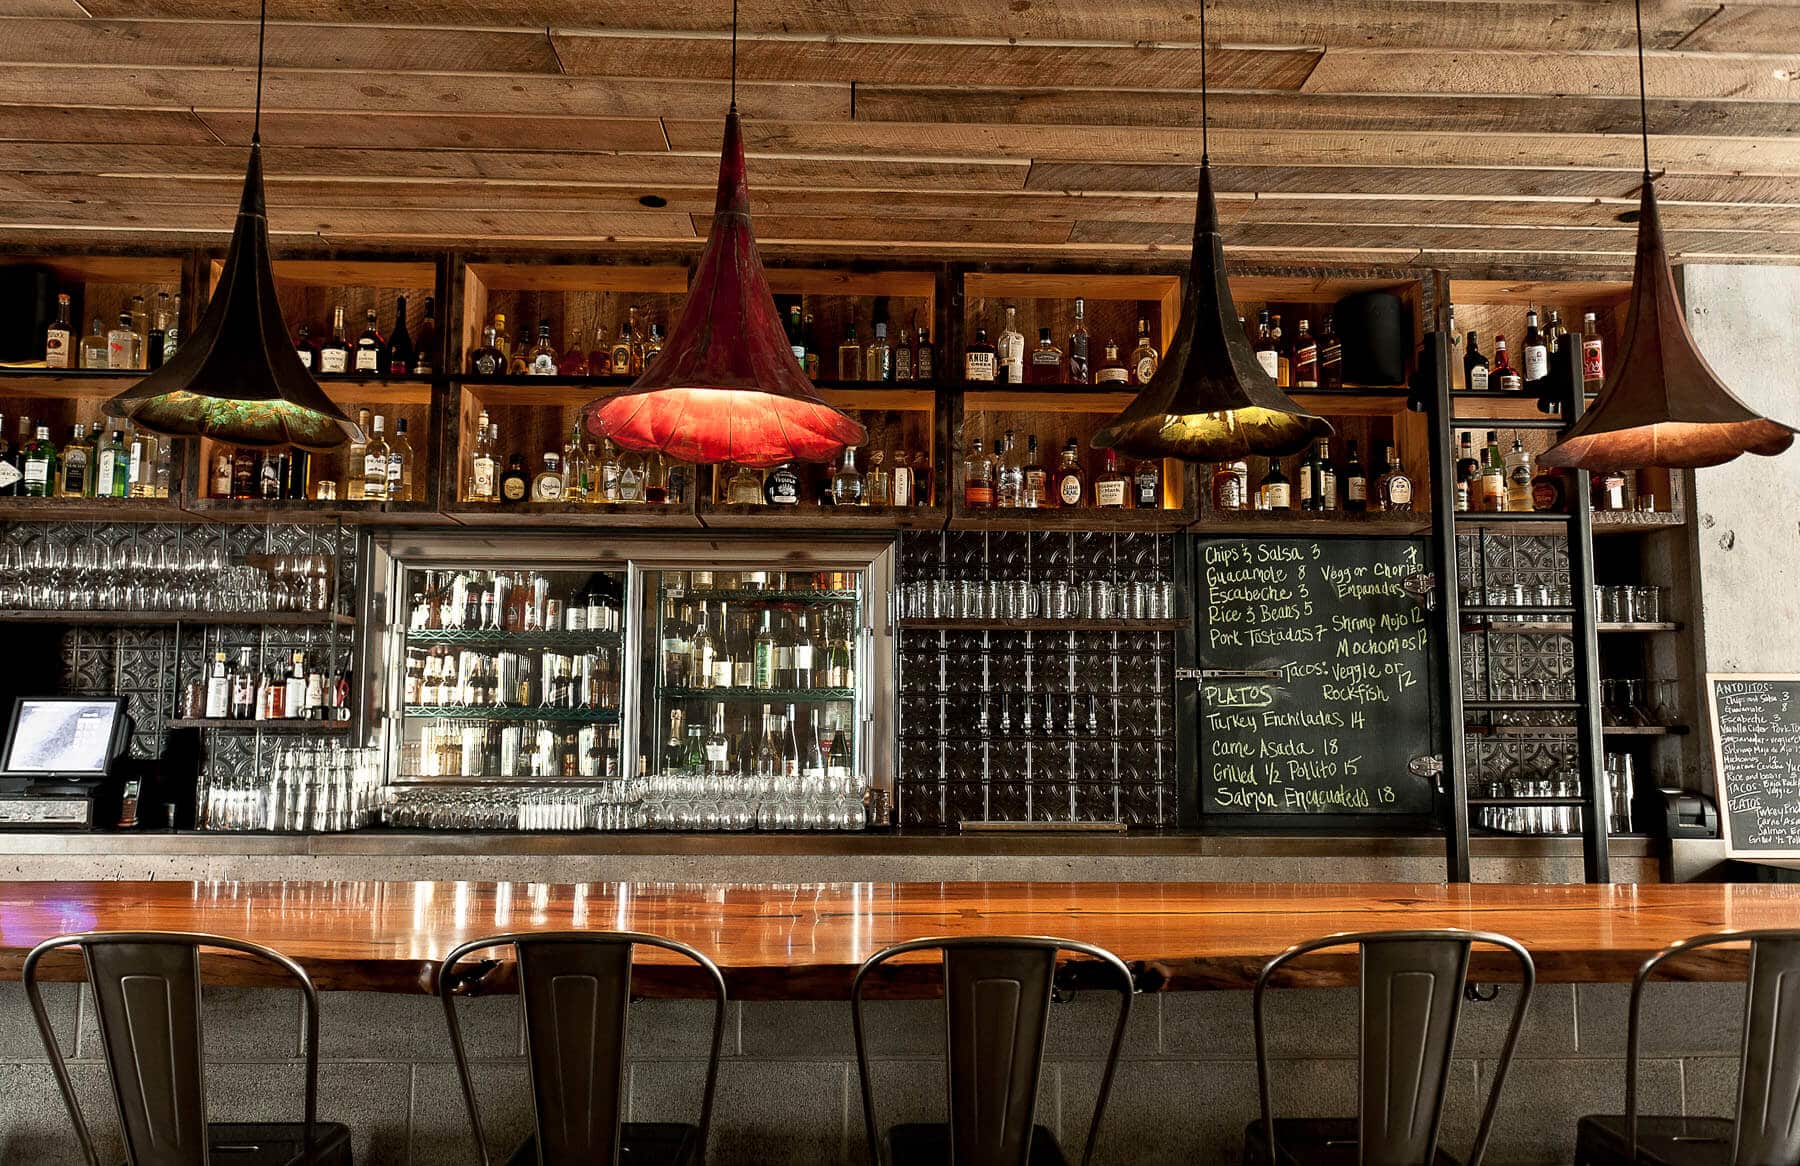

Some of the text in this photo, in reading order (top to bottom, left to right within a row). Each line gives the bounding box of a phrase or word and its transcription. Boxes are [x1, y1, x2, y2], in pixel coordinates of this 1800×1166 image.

[969, 354, 989, 362] KNOB
[1205, 545, 1239, 567] Chips
[1257, 544, 1304, 561] Salsa
[1310, 543, 1321, 560] 3
[1403, 545, 1418, 564] 7
[1206, 565, 1306, 587] Guacamole 8
[1354, 567, 1368, 576] or
[1374, 562, 1424, 578] Chorizo
[1209, 584, 1309, 605] Escabeche 3
[1338, 582, 1406, 600] Empanadas
[1208, 606, 1242, 625] Rice
[1260, 603, 1300, 624] Beans
[1304, 601, 1313, 616] 5
[1332, 607, 1424, 633] Shrimp Mojo 12
[1210, 625, 1328, 648] Pork Tostadas 7
[1418, 628, 1427, 650] 12
[1281, 662, 1329, 682] Tacos:
[1385, 662, 1403, 674] or
[1399, 670, 1416, 692] 12
[1204, 685, 1273, 706] PLATOS
[1323, 684, 1389, 704] Rockfish
[1782, 691, 1790, 701] 3
[1773, 714, 1781, 722] 3
[1782, 703, 1788, 712] 8
[1206, 711, 1366, 732] Turkey Enchiladas 14
[1259, 739, 1314, 758] Asada
[1323, 739, 1339, 755] 18
[1213, 755, 1362, 785] Grilled 1/2 Pollito 15
[1214, 787, 1277, 812] Salmon
[1377, 786, 1395, 803] 18
[1758, 825, 1787, 836] Salmon
